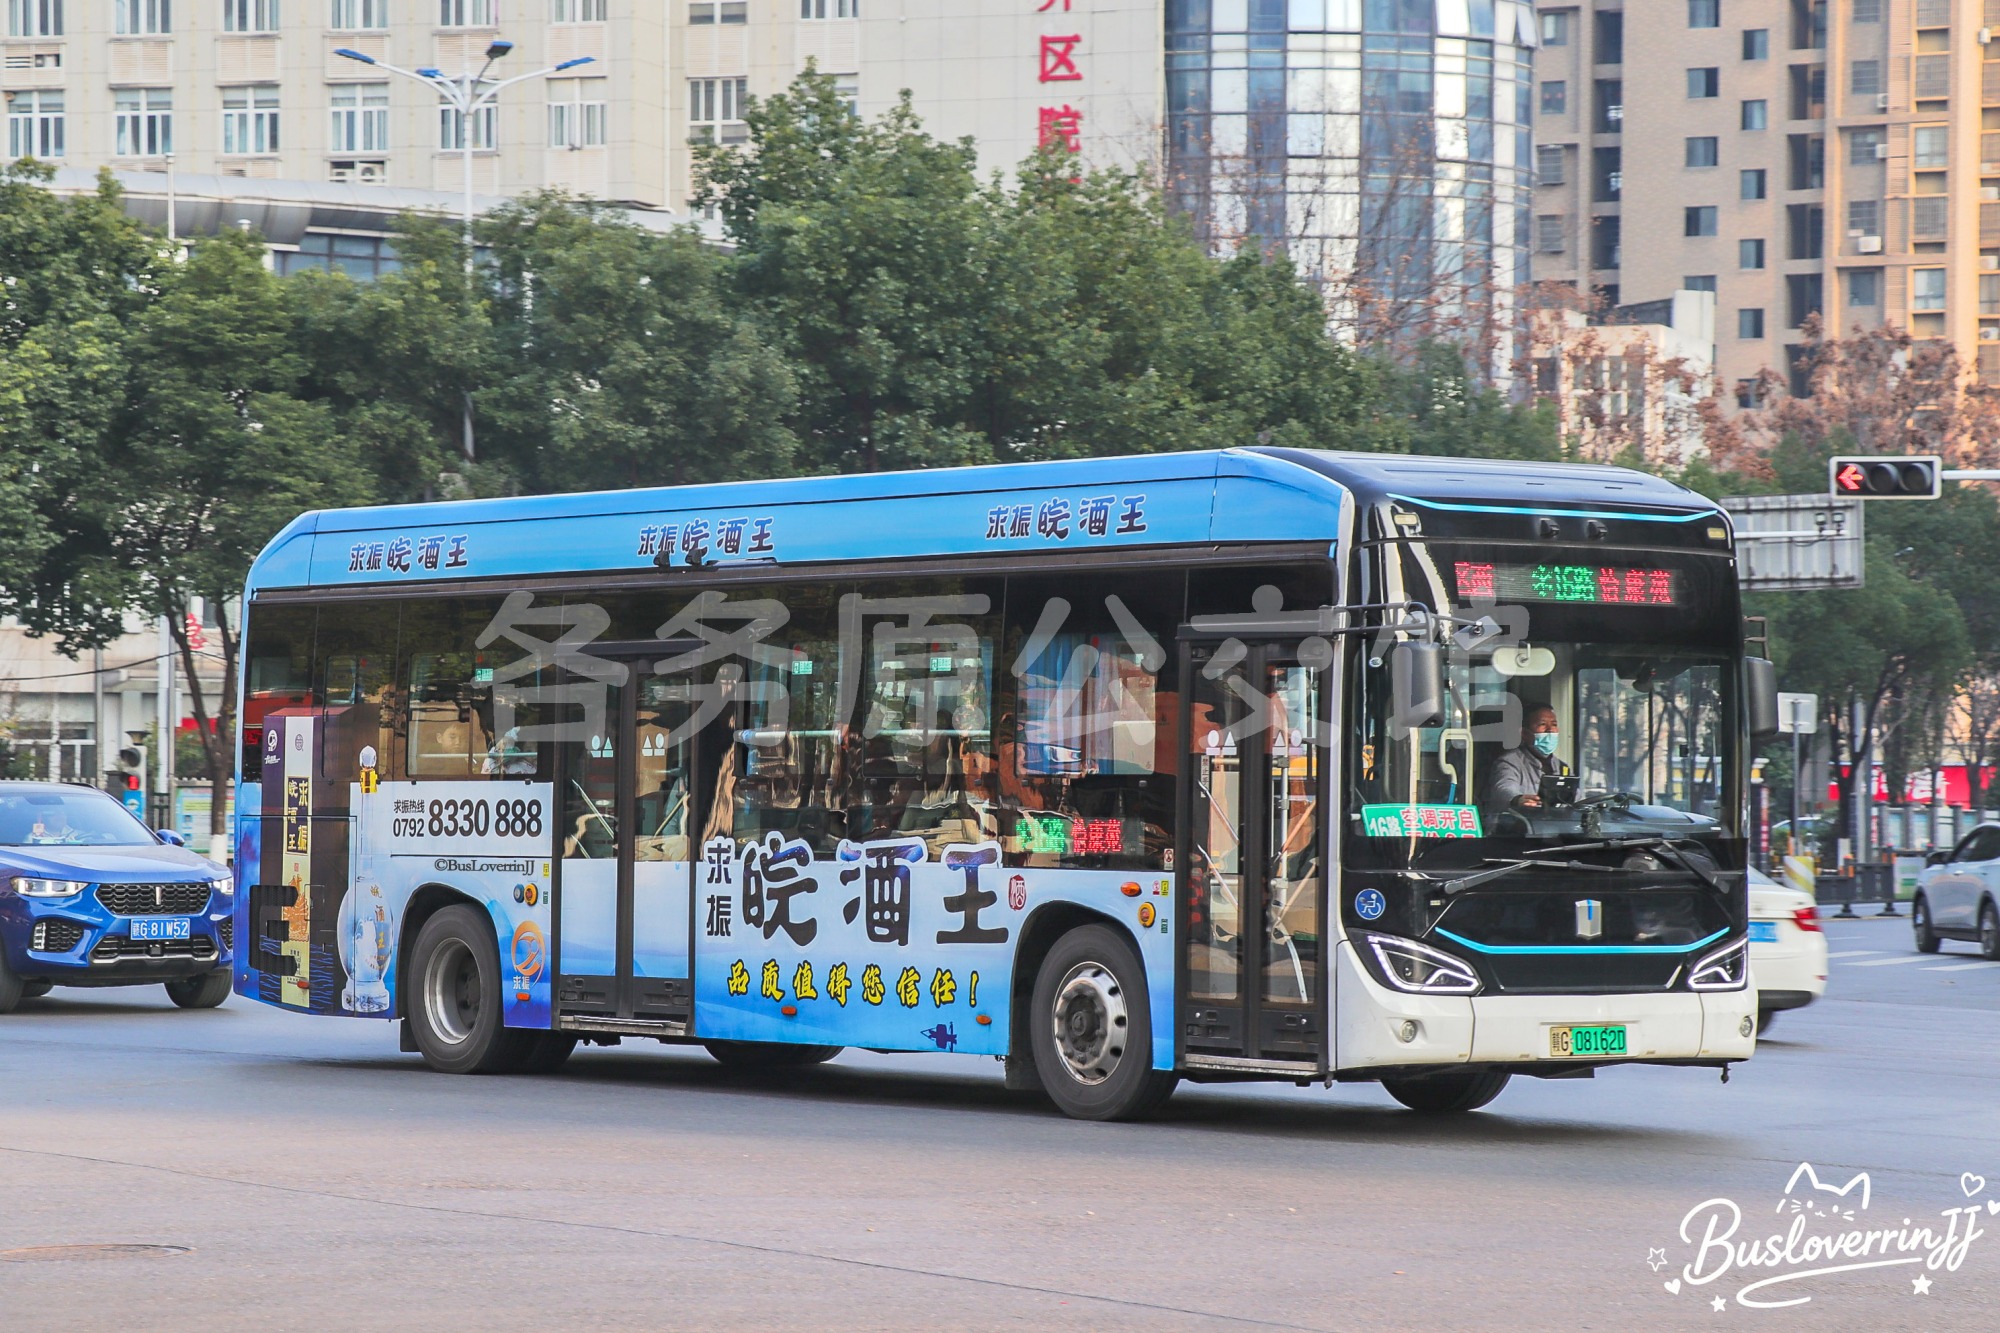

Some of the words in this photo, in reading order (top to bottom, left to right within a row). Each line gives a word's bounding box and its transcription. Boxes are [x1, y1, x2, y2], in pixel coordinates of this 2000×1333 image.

[985, 494, 1148, 541] 求振皖酒王
[348, 534, 469, 574] 求振皖酒王
[393, 799, 425, 814] 求振热线
[393, 817, 425, 838] 0792
[428, 798, 490, 837] 8330
[494, 798, 543, 838] 888
[1400, 808, 1477, 830] 空调开启
[706, 843, 732, 936] 求振
[742, 836, 1009, 946] 皖酒王
